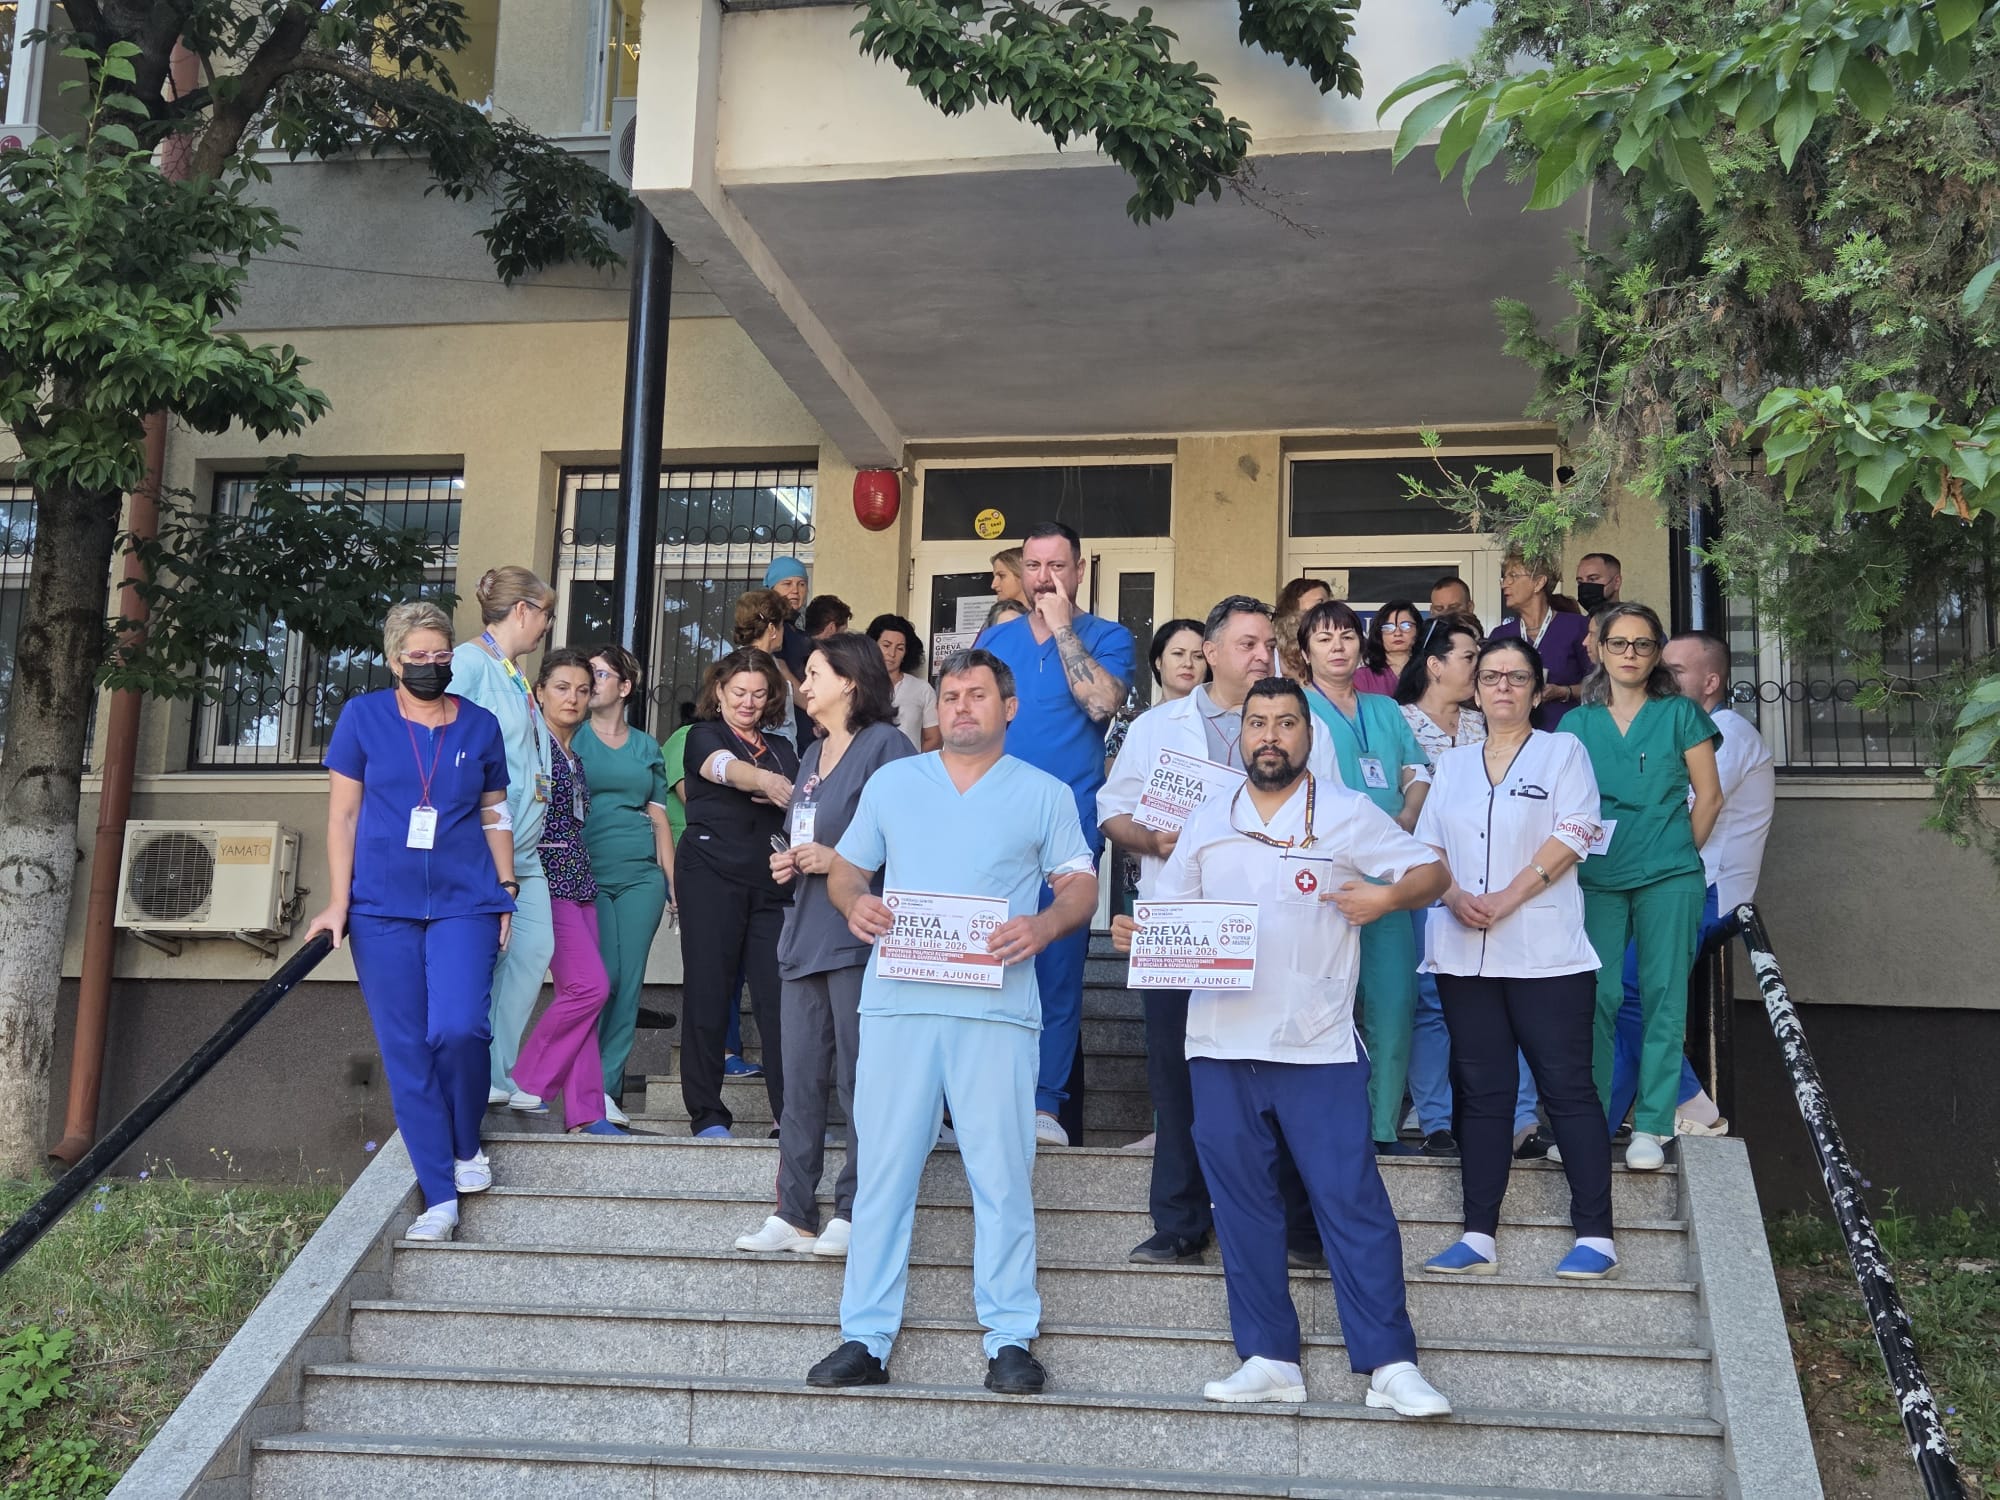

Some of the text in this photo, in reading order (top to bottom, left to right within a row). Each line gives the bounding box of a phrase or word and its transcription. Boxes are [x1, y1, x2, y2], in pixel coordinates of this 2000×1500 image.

[1147, 787, 1162, 798] din
[1165, 792, 1176, 801] 28
[220, 844, 270, 857] YAMATO
[893, 915, 941, 929] REVĂ
[1221, 923, 1252, 933] STOP
[1138, 924, 1191, 935] GREVĂ
[885, 936, 968, 951] din 28 iulie 2026
[1136, 935, 1210, 946] GENERALĂ
[1136, 946, 1218, 956] din 28 iulie 2026
[889, 966, 991, 981] SPUNEM: AJUNGE!
[1141, 975, 1241, 985] SPUNEM: AJUNGE!
